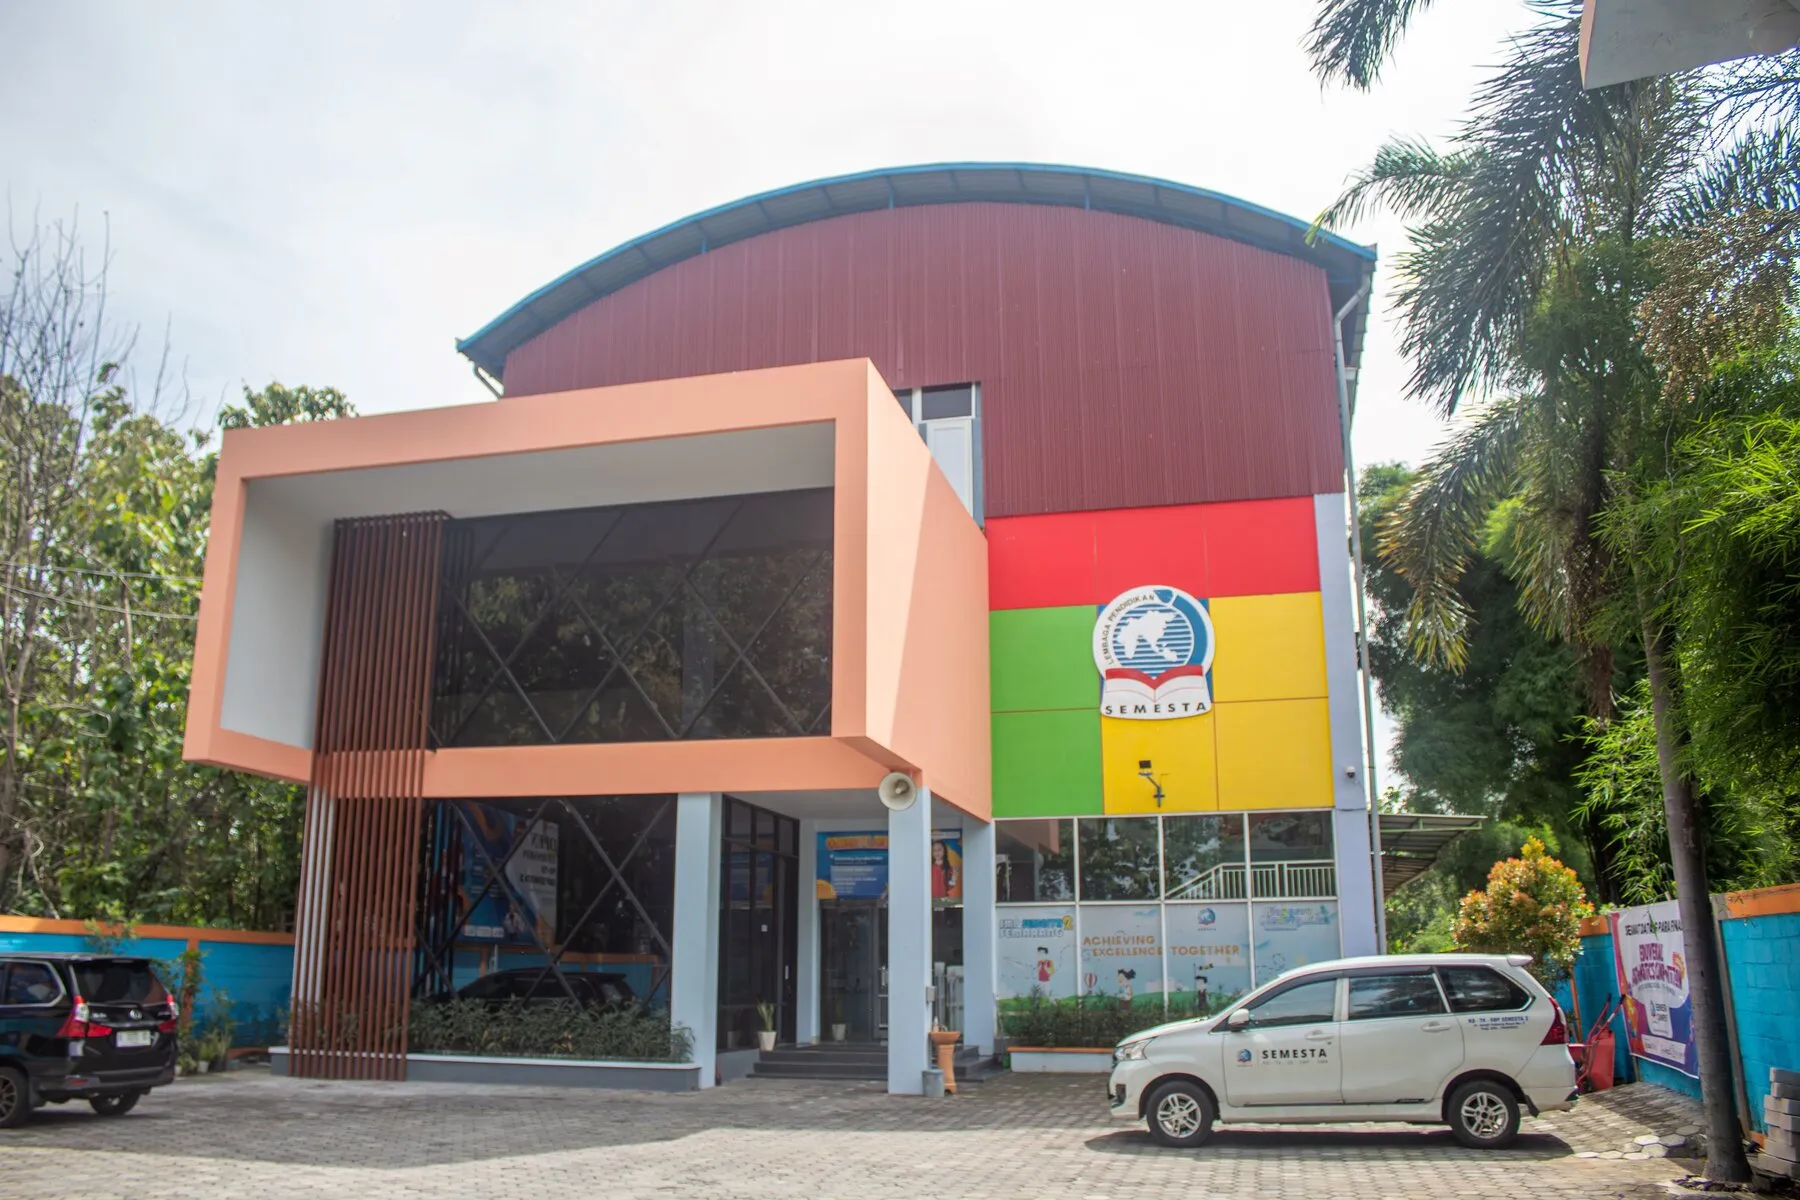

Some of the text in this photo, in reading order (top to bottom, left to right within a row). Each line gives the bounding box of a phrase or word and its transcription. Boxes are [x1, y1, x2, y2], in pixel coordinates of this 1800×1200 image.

[1101, 624, 1115, 666] LEMBAGA
[1104, 702, 1207, 715] SEMESTA
[1083, 935, 1155, 946] ACHIEVING
[1092, 945, 1239, 957] EXCELLENCE TOGETHER
[1262, 1048, 1327, 1059] SEMESTA
